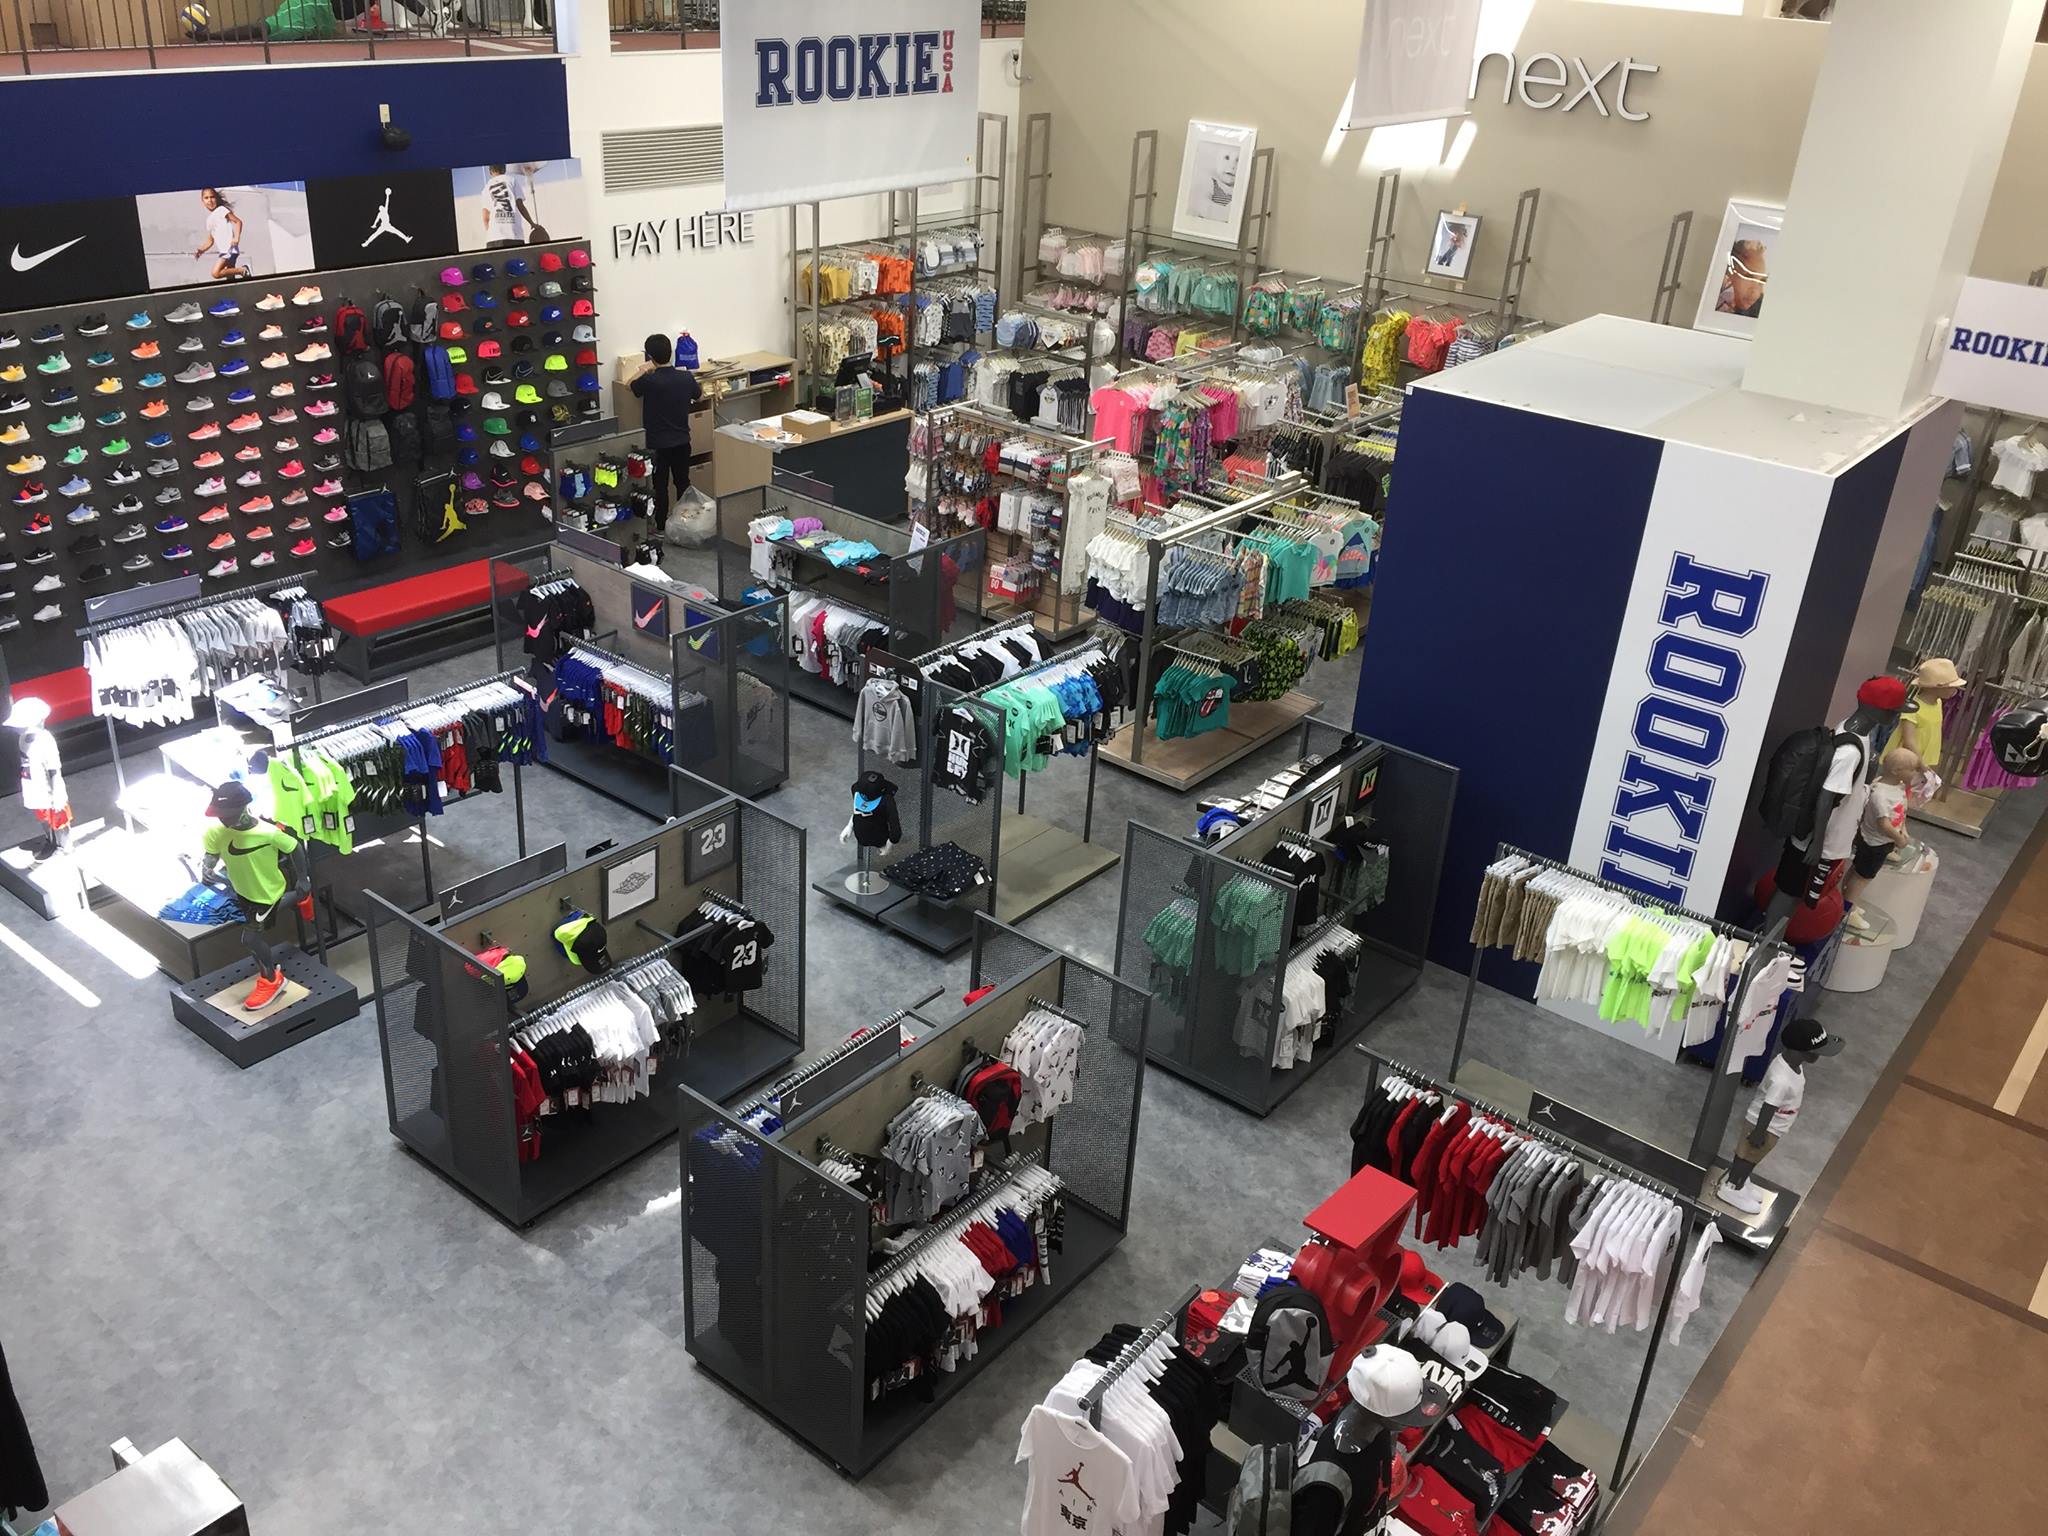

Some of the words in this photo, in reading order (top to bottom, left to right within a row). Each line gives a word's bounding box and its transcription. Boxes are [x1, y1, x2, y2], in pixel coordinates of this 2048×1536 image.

[755, 30, 941, 108] ROOKIE
[941, 29, 955, 93] USA
[1468, 50, 1661, 122] next
[613, 219, 667, 259] PAY
[676, 211, 755, 251] HERE
[701, 823, 726, 856] 23
[731, 940, 758, 971] 23
